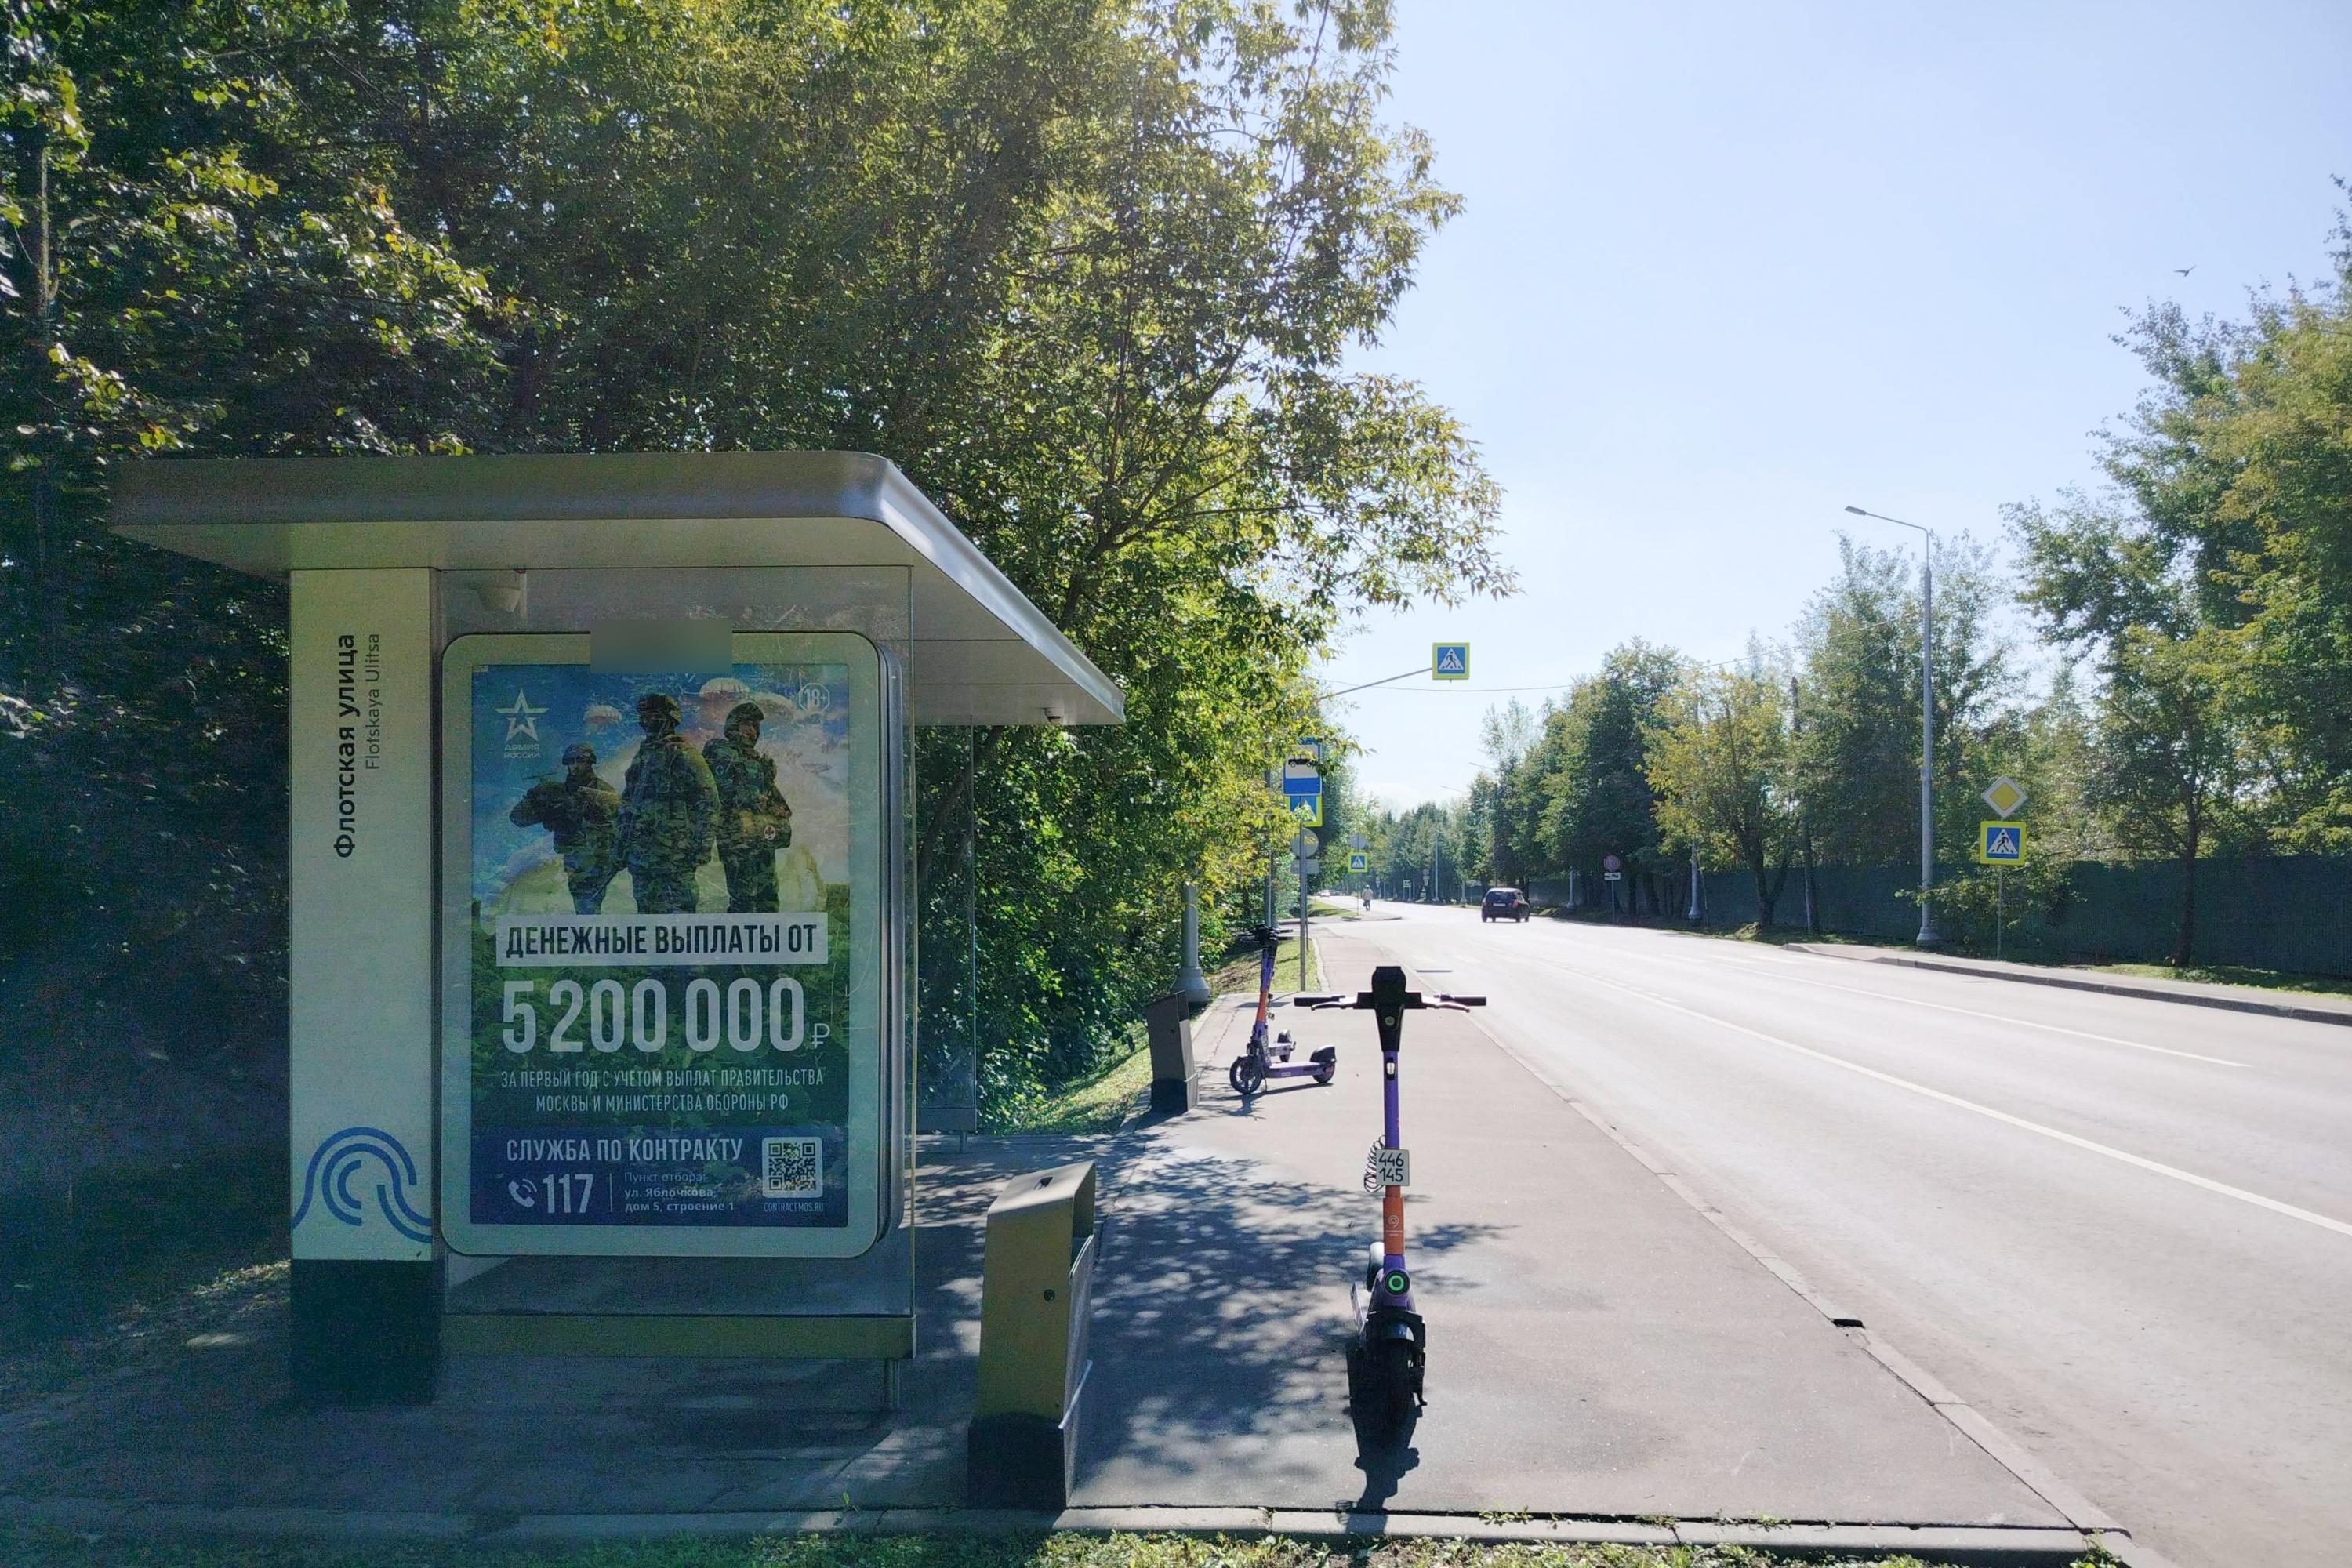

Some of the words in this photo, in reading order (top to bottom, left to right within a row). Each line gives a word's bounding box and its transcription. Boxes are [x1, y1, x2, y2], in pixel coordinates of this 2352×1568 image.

[365, 633, 380, 682] Ulitsa
[339, 634, 361, 717] улица
[804, 688, 828, 709] 18+
[365, 688, 383, 770] Flotskaya
[333, 725, 356, 858] Флотская
[506, 924, 648, 958] ДЕНЕЖНЫЕ
[655, 924, 779, 954] ВЫПЛАТЫ
[788, 924, 817, 953] ОТ
[502, 980, 537, 1054] 5
[549, 978, 667, 1053] 200
[685, 977, 804, 1052] 000
[500, 1070, 517, 1087] ЗА
[521, 1068, 572, 1087] ПЕРВЫЙ
[575, 1070, 598, 1089] ГОД
[603, 1070, 609, 1087] С
[614, 1070, 662, 1087] УЧЕТОМ
[666, 1069, 717, 1087] ВЫПЛАТ
[721, 1069, 824, 1087] ПРАВИТЕЛЬСТВА
[536, 1095, 588, 1112] МОСКВЫ
[593, 1095, 601, 1112] И
[606, 1094, 702, 1112] МИНИСТЕРСТВА
[706, 1094, 766, 1111] ОБОРОНЫ
[771, 1093, 789, 1110] РФ
[506, 1138, 590, 1162] СЛУЖБА
[597, 1138, 622, 1161] ПО
[628, 1138, 743, 1162] КОНТРАКТУ
[1378, 1152, 1404, 1167] 446
[624, 1172, 658, 1184] Пункт
[1378, 1167, 1404, 1182] 145
[542, 1173, 594, 1214] 117
[624, 1189, 643, 1200] ул.
[645, 1187, 717, 1198] Яблочкова,
[625, 1203, 650, 1213] дом
[653, 1202, 663, 1212] 5,
[666, 1203, 725, 1213] строение
[729, 1202, 734, 1210] 1
